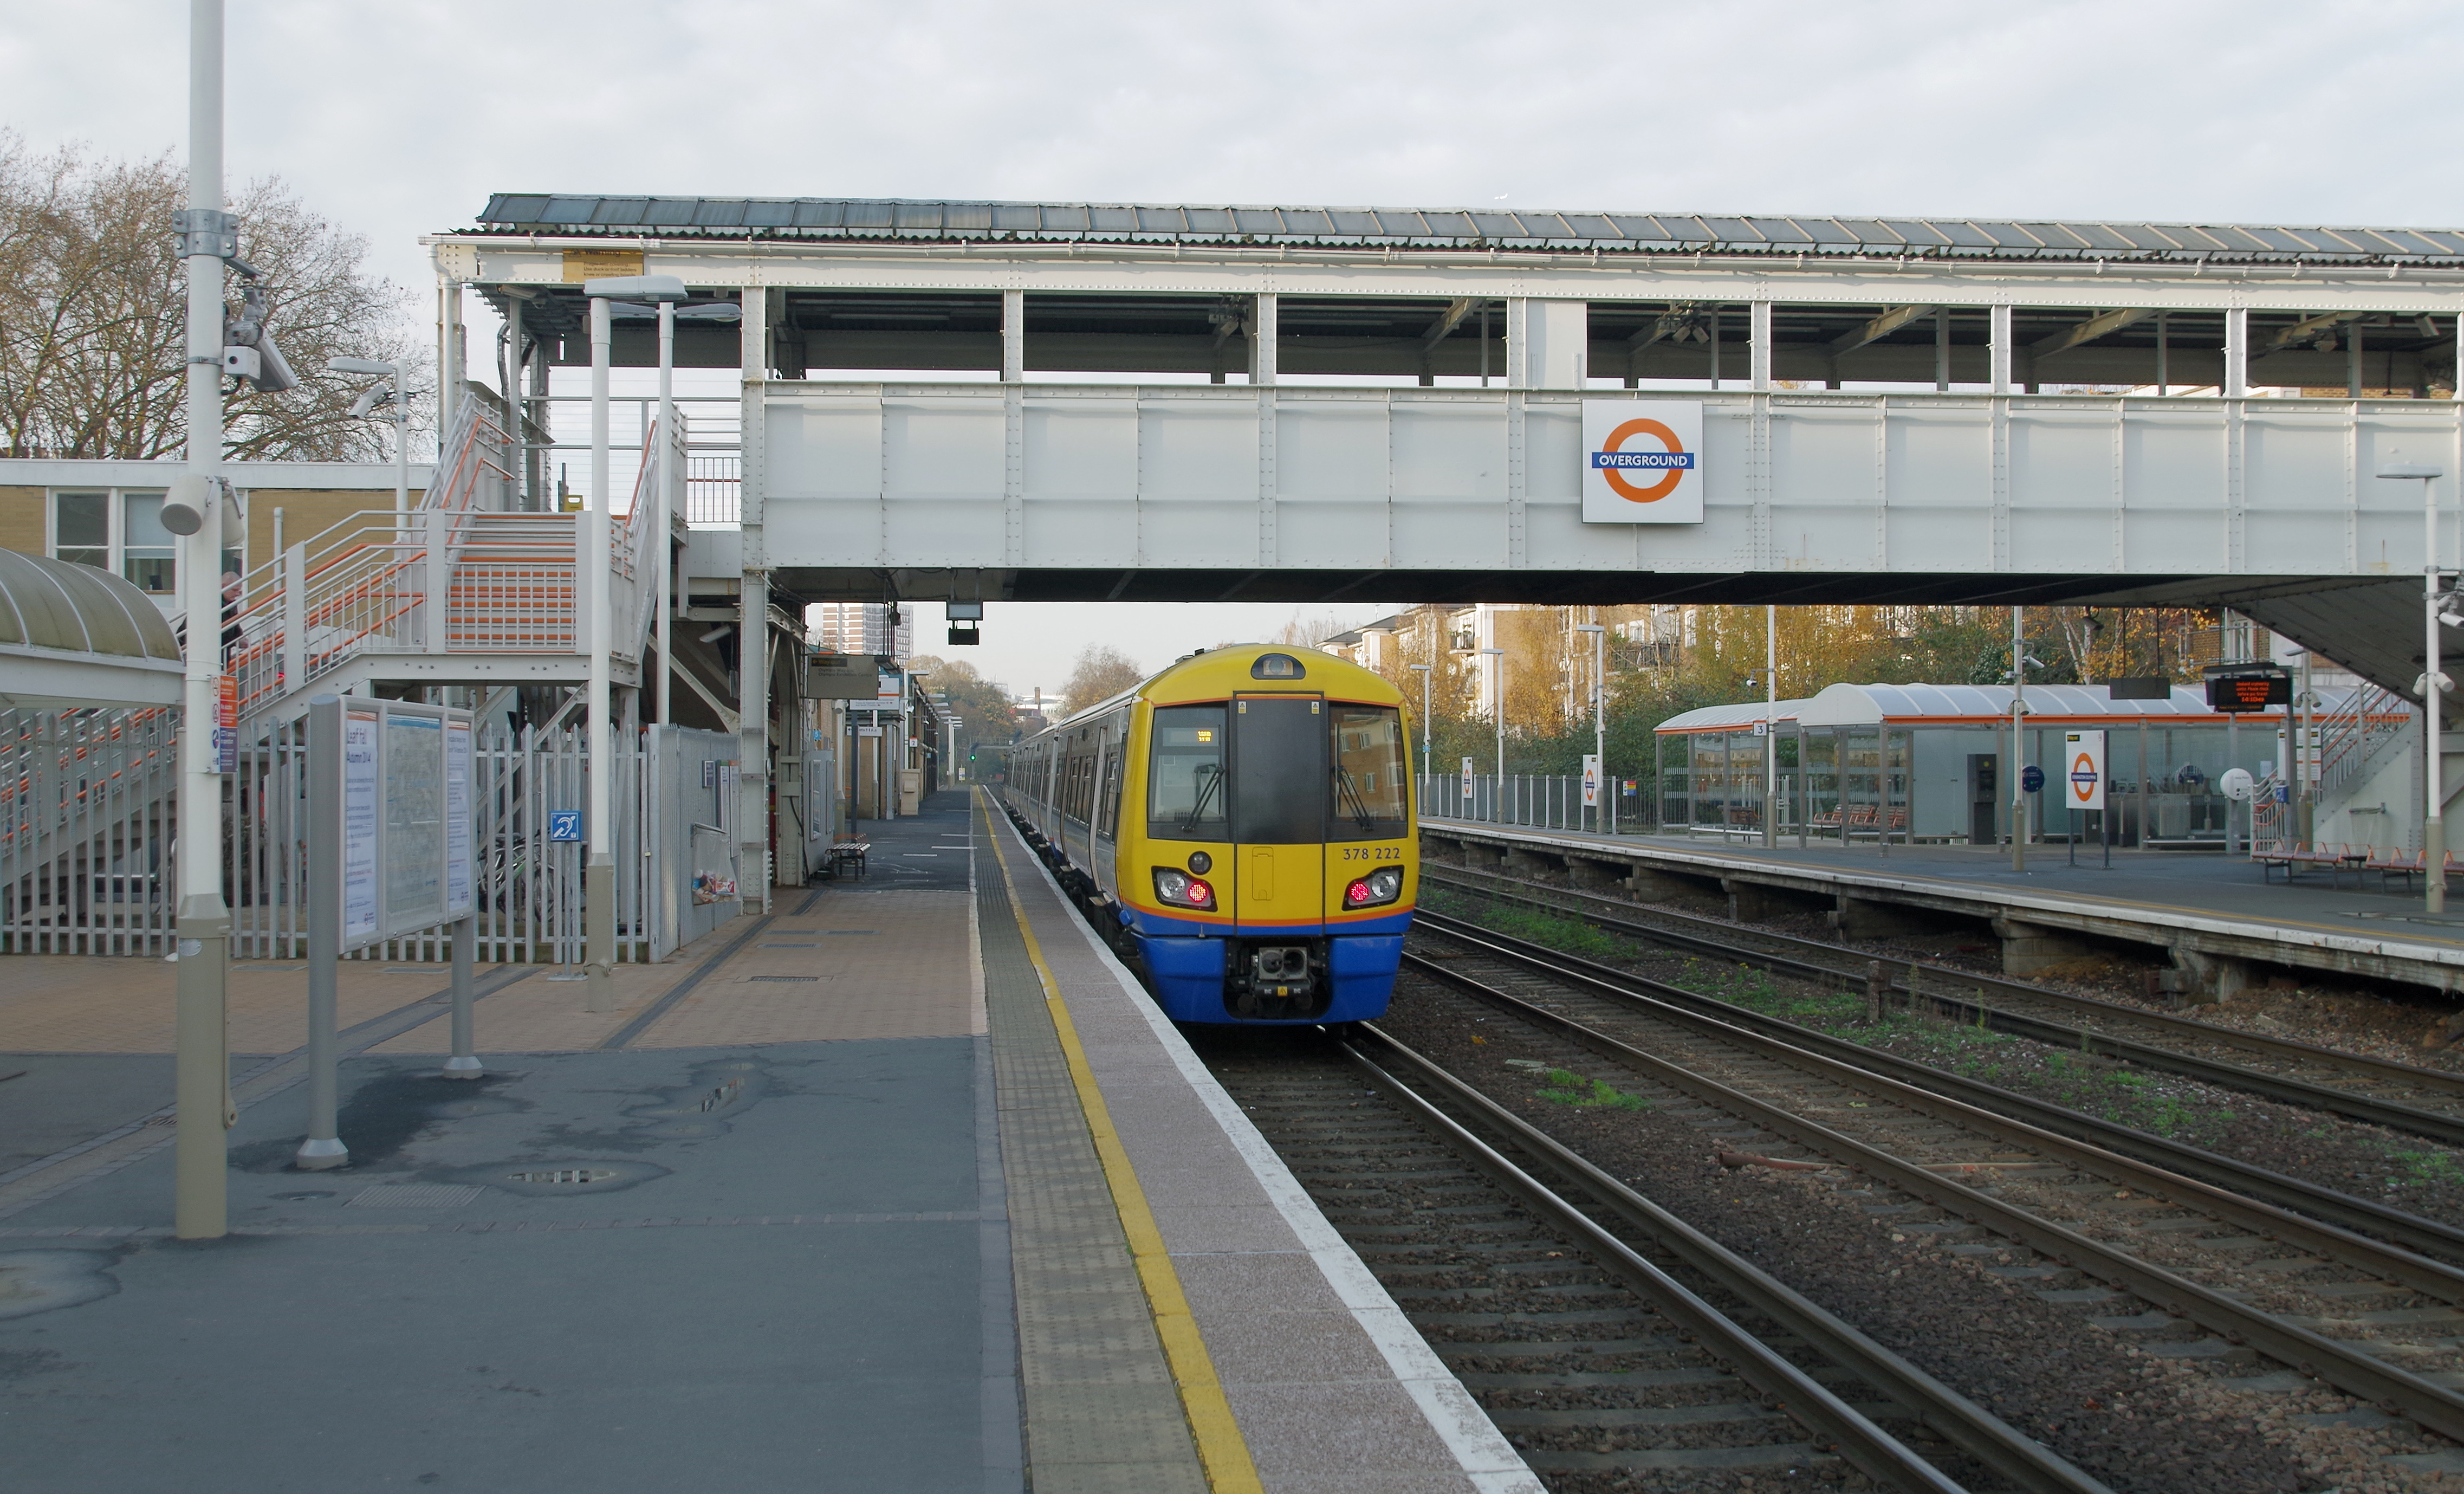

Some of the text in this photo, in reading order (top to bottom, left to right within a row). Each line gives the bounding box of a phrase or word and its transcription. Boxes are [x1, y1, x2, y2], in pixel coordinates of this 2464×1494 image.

[585, 249, 621, 257] Warning
[1599, 455, 1688, 467] OVERGROUND
[1758, 726, 1763, 734] 3
[1343, 848, 1400, 861] 378 222
